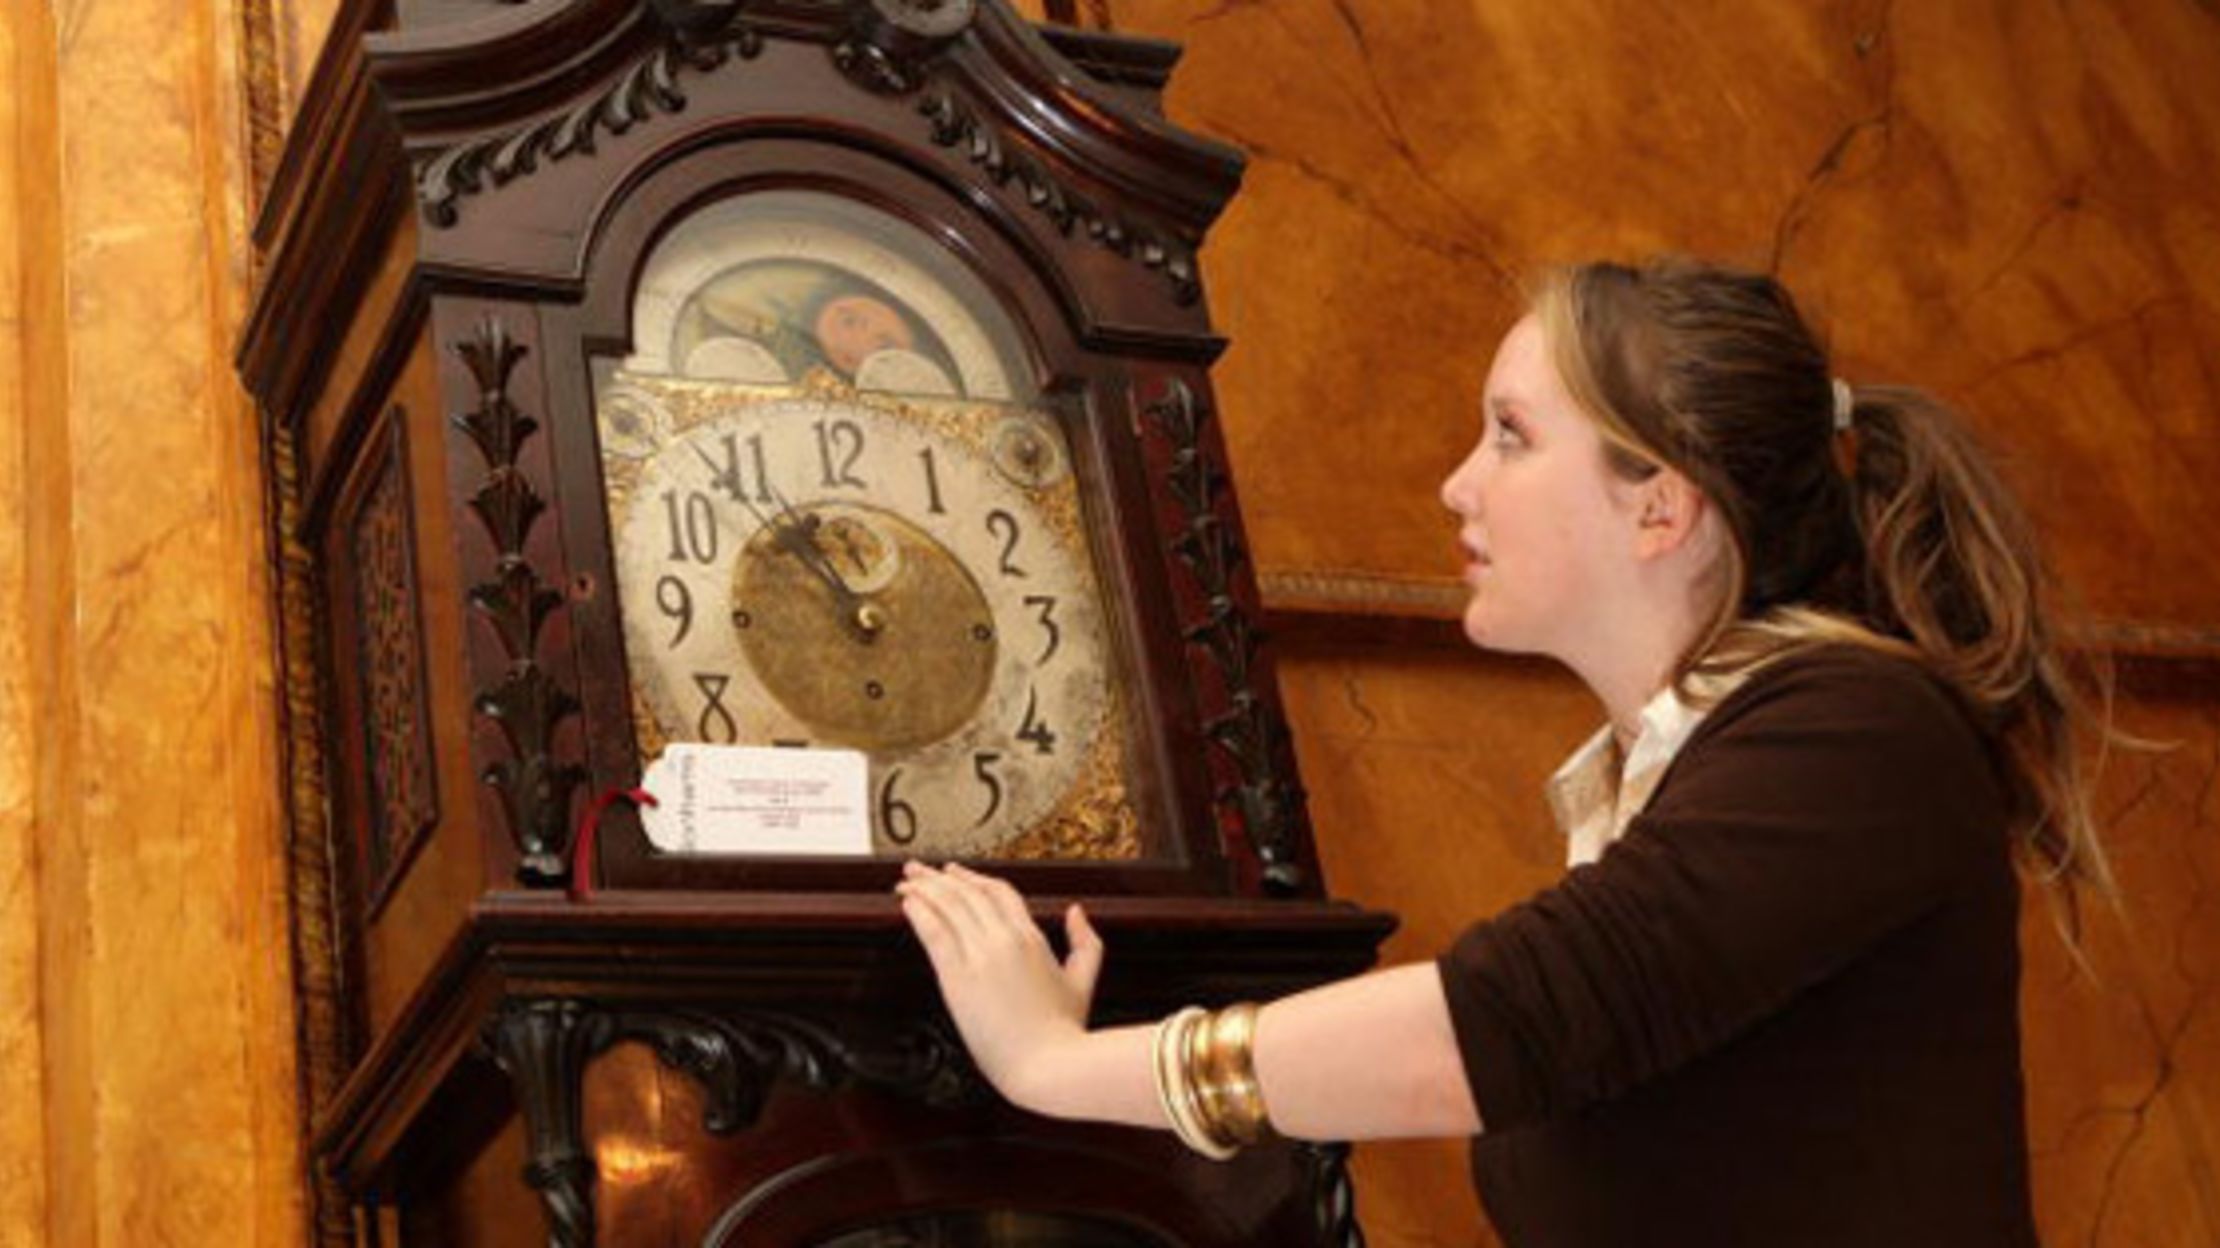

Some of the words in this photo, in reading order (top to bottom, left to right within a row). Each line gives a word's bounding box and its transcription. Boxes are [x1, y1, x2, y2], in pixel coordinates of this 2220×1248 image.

[721, 435, 774, 503] 11
[813, 419, 867, 490] 12
[919, 447, 946, 514] 1
[661, 490, 717, 564] 10
[986, 509, 1026, 577] 2
[656, 575, 693, 650] 9
[1024, 596, 1061, 666] 3
[693, 674, 737, 743] 8
[1015, 686, 1056, 753] 4
[880, 768, 917, 845] 6
[974, 754, 1001, 825] 5
